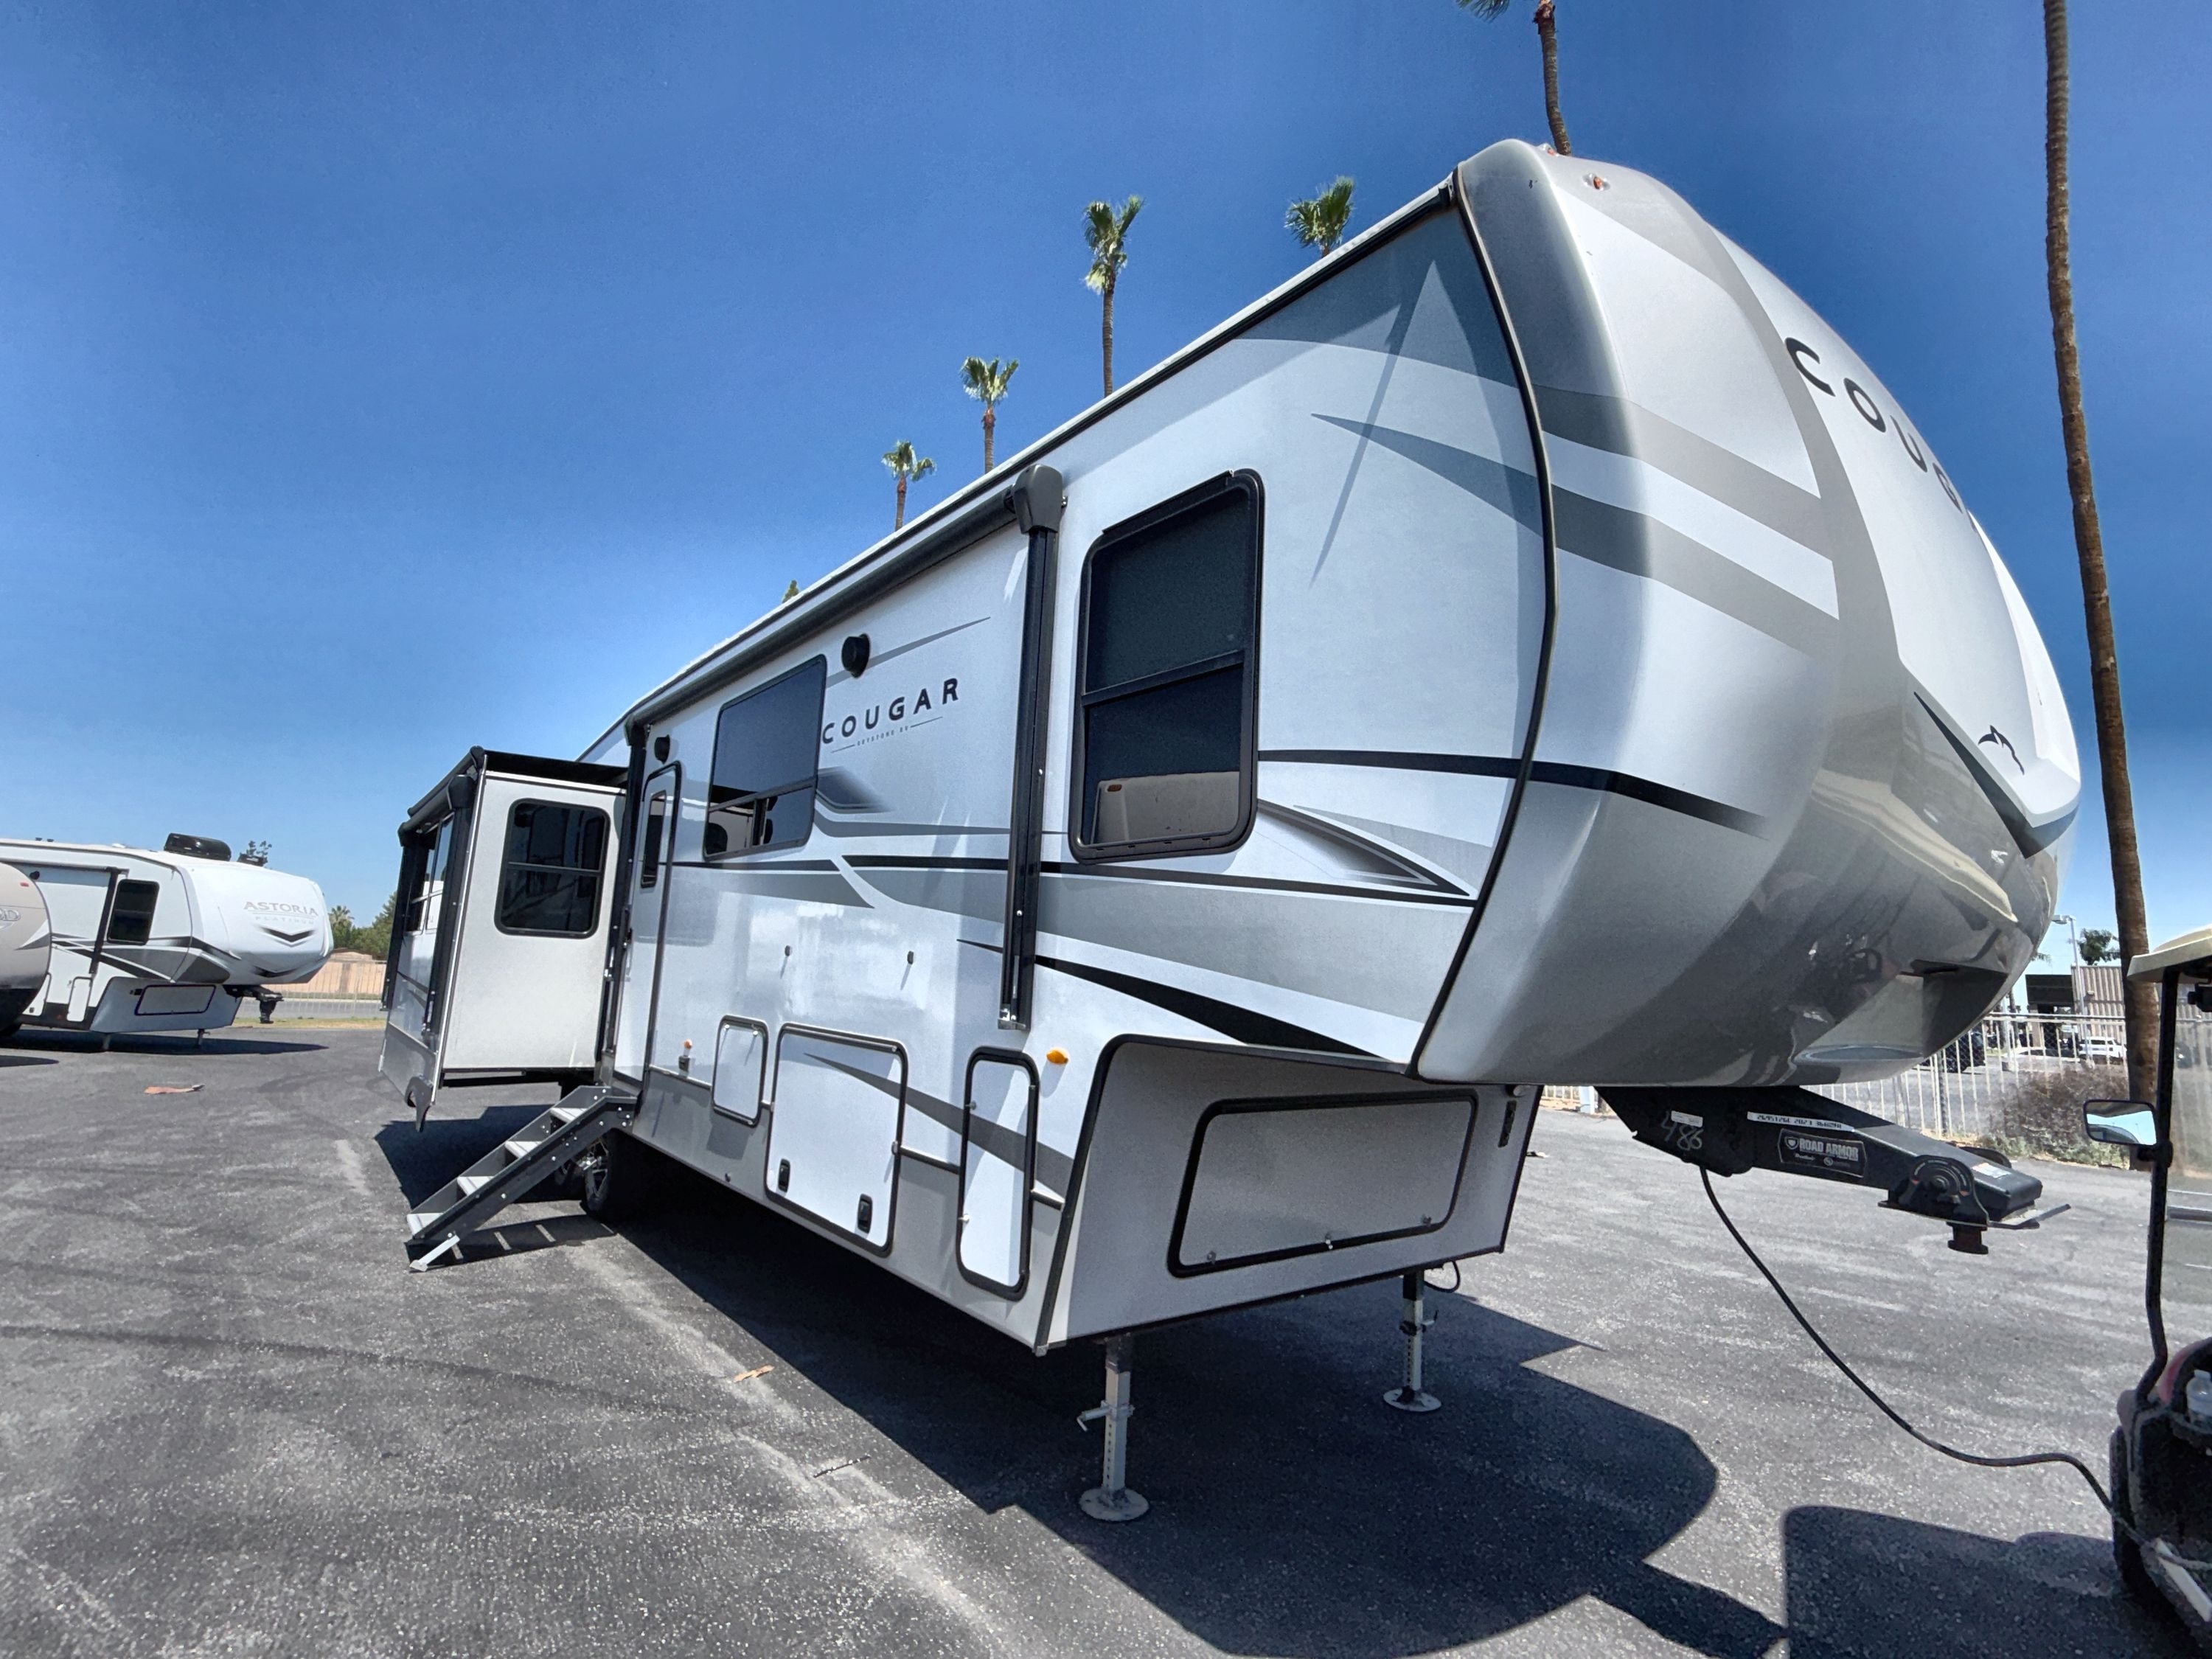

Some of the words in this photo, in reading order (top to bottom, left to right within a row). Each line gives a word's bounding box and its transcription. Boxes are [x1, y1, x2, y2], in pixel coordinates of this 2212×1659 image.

[1784, 336, 1977, 532] COUG
[822, 678, 959, 745] COUGAR
[243, 901, 318, 916] ASTORIA
[1660, 1110, 1704, 1150] 486
[1799, 1138, 1824, 1154] ROAD
[1826, 1143, 1858, 1161] ARMOR
